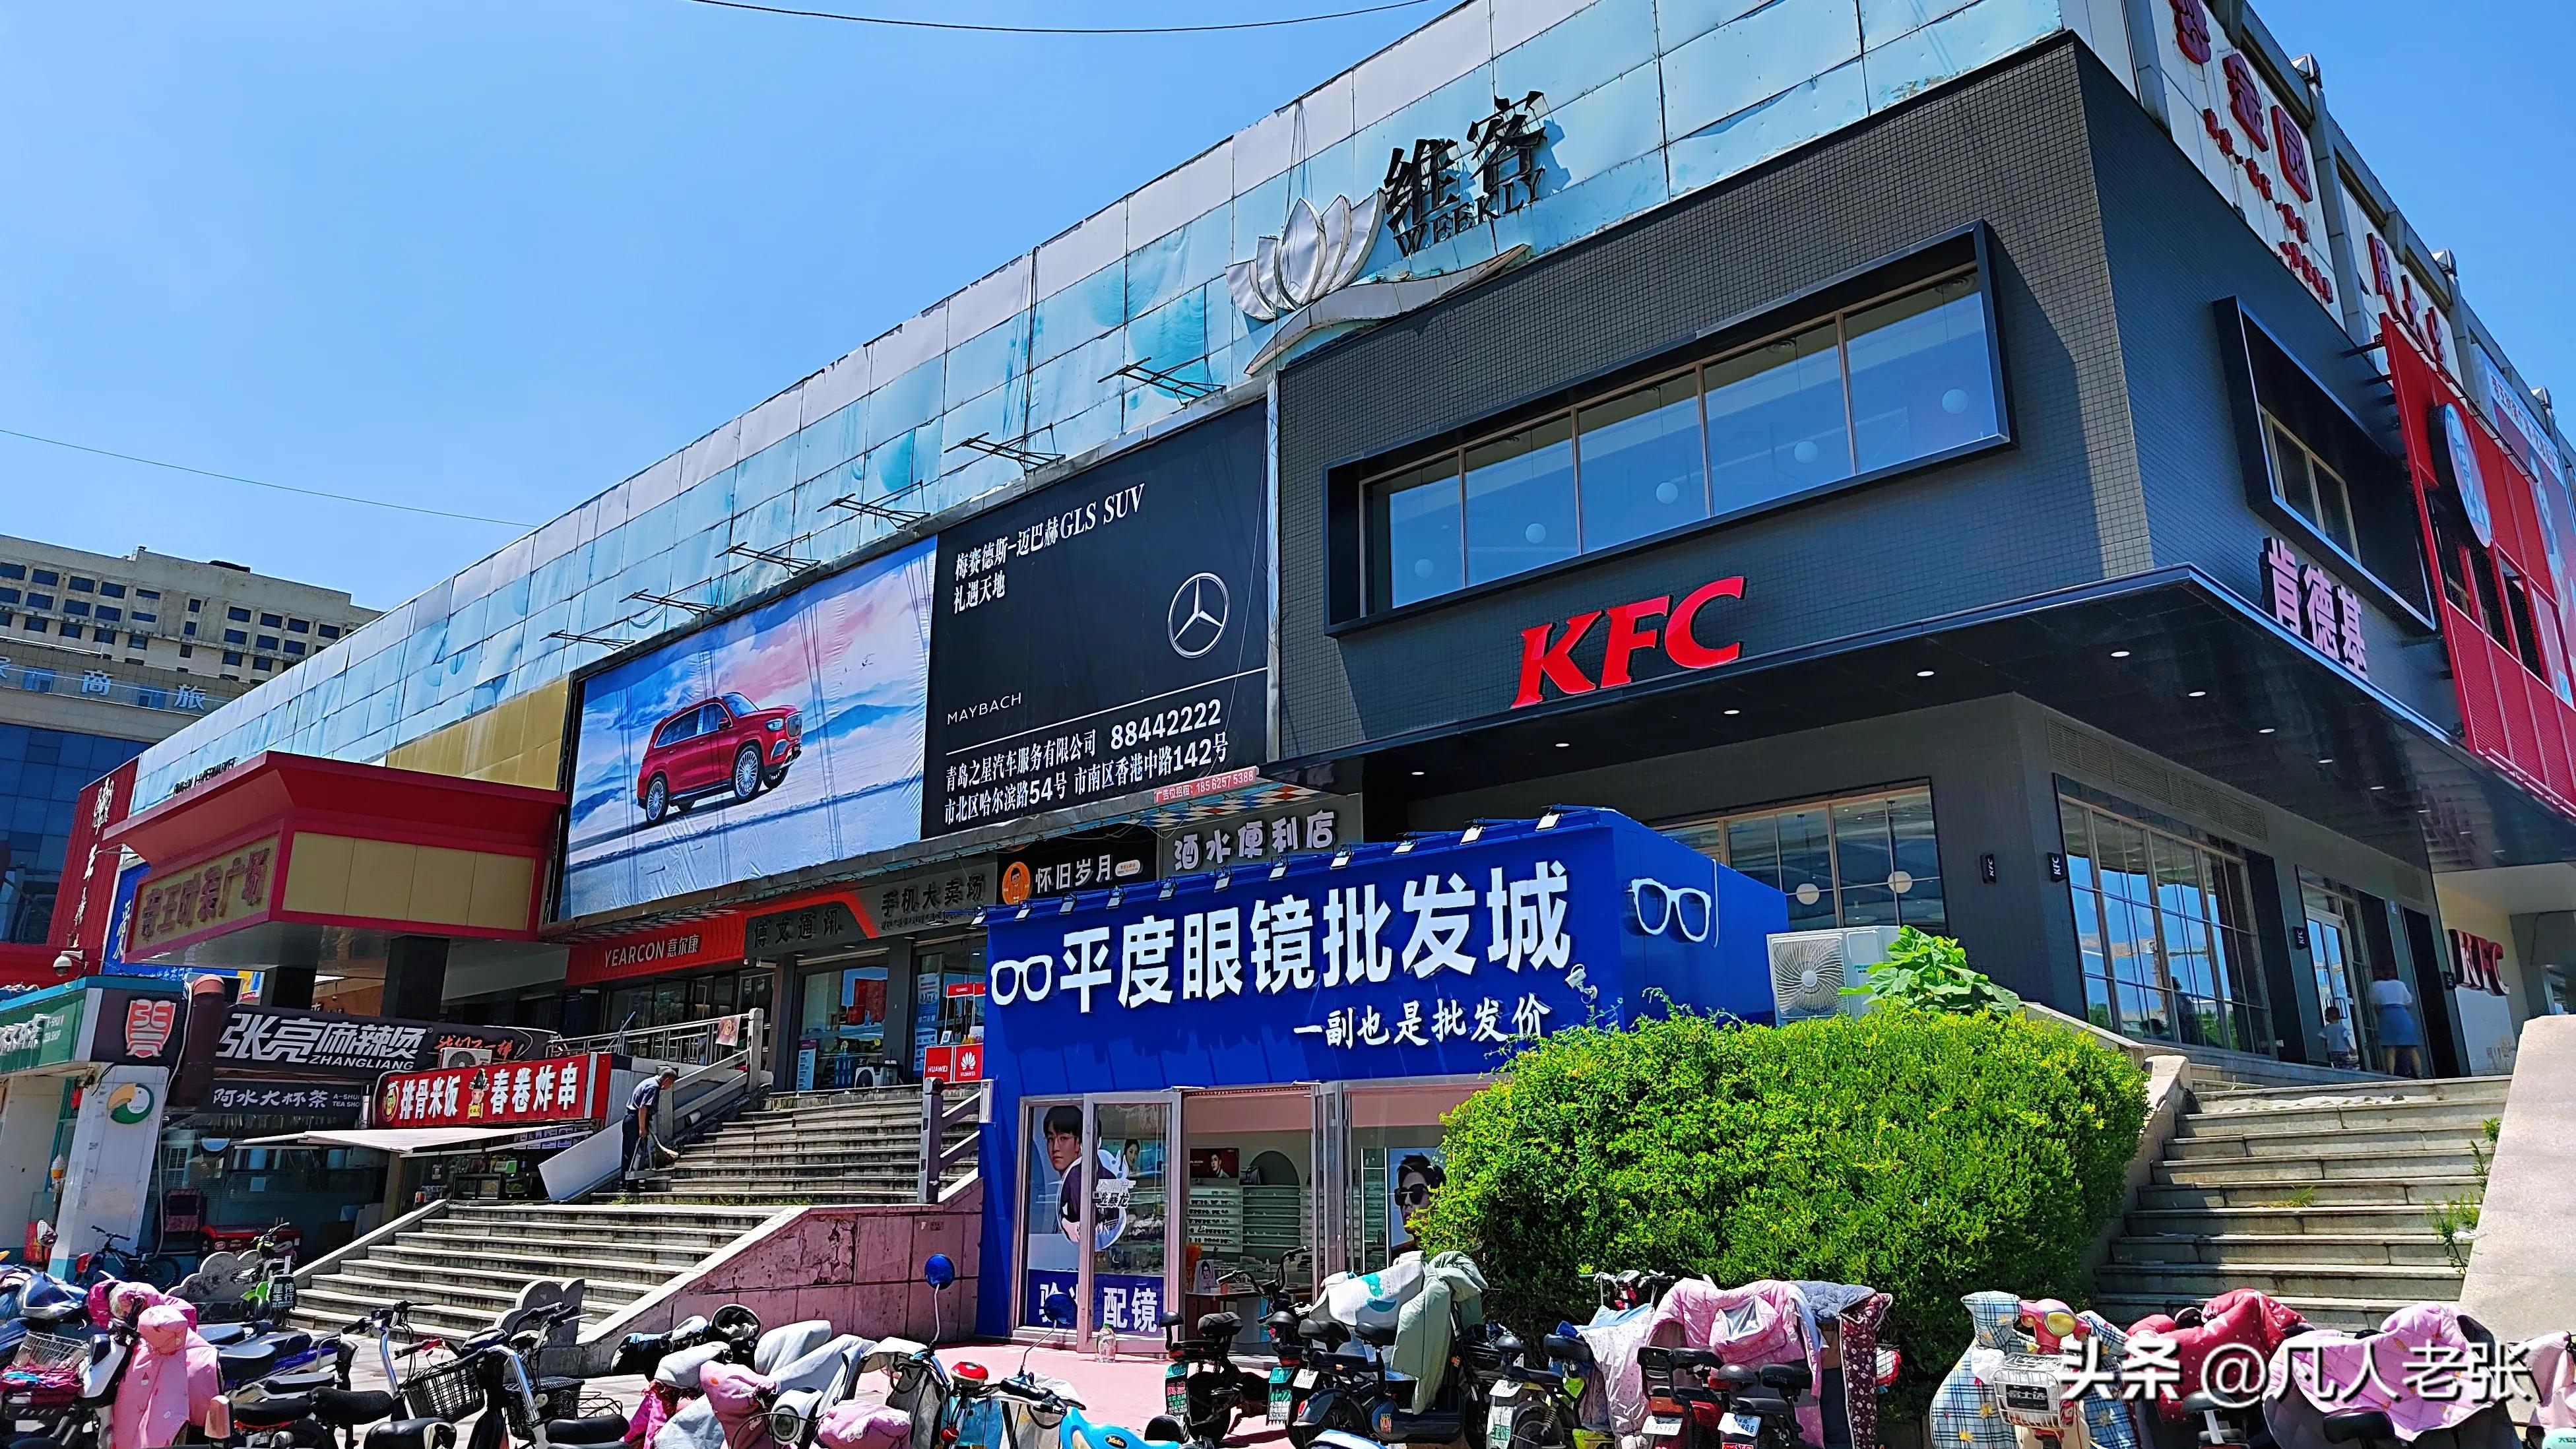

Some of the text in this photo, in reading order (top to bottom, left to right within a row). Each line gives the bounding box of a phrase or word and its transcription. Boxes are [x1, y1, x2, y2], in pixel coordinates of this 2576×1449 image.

[1383, 91, 1547, 234] 维客
[1394, 168, 1545, 257] WEEKLY
[1104, 483, 1145, 525] SUV
[953, 569, 1006, 614] 礼遇天地
[2263, 538, 2367, 680] 肯德基
[1511, 576, 1745, 708] KFC
[948, 692, 1022, 725] MAYBACH
[946, 699, 1221, 792] 青岛之星汽车服务有限公司 88442222
[945, 730, 1229, 825] 市北区哈尔滨路54号 市南区香港中路142号
[1196, 781, 1210, 794] 185
[1211, 775, 1231, 790] 6257
[1233, 770, 1254, 785] 5388
[1174, 810, 1337, 872] 酒水便利店
[1035, 854, 1112, 893] 怀旧岁月
[2052, 856, 2061, 876] KFC
[882, 875, 984, 917] 手机大卖场
[754, 907, 843, 948] 博文通讯
[1060, 860, 1577, 1013] 平度眼镜批发城
[604, 934, 699, 969] YEARCON 意尔康
[2449, 929, 2509, 996] KFC
[215, 1013, 426, 1063] 张亮麻辣烫
[1295, 994, 1553, 1050] 一副也是批发价
[308, 1055, 414, 1071] ZHANGLIANG
[213, 1089, 329, 1109] 阿水大杯茶
[399, 1062, 578, 1120] 排骨米饭 春卷炸串
[1103, 1287, 1158, 1332] 配镜
